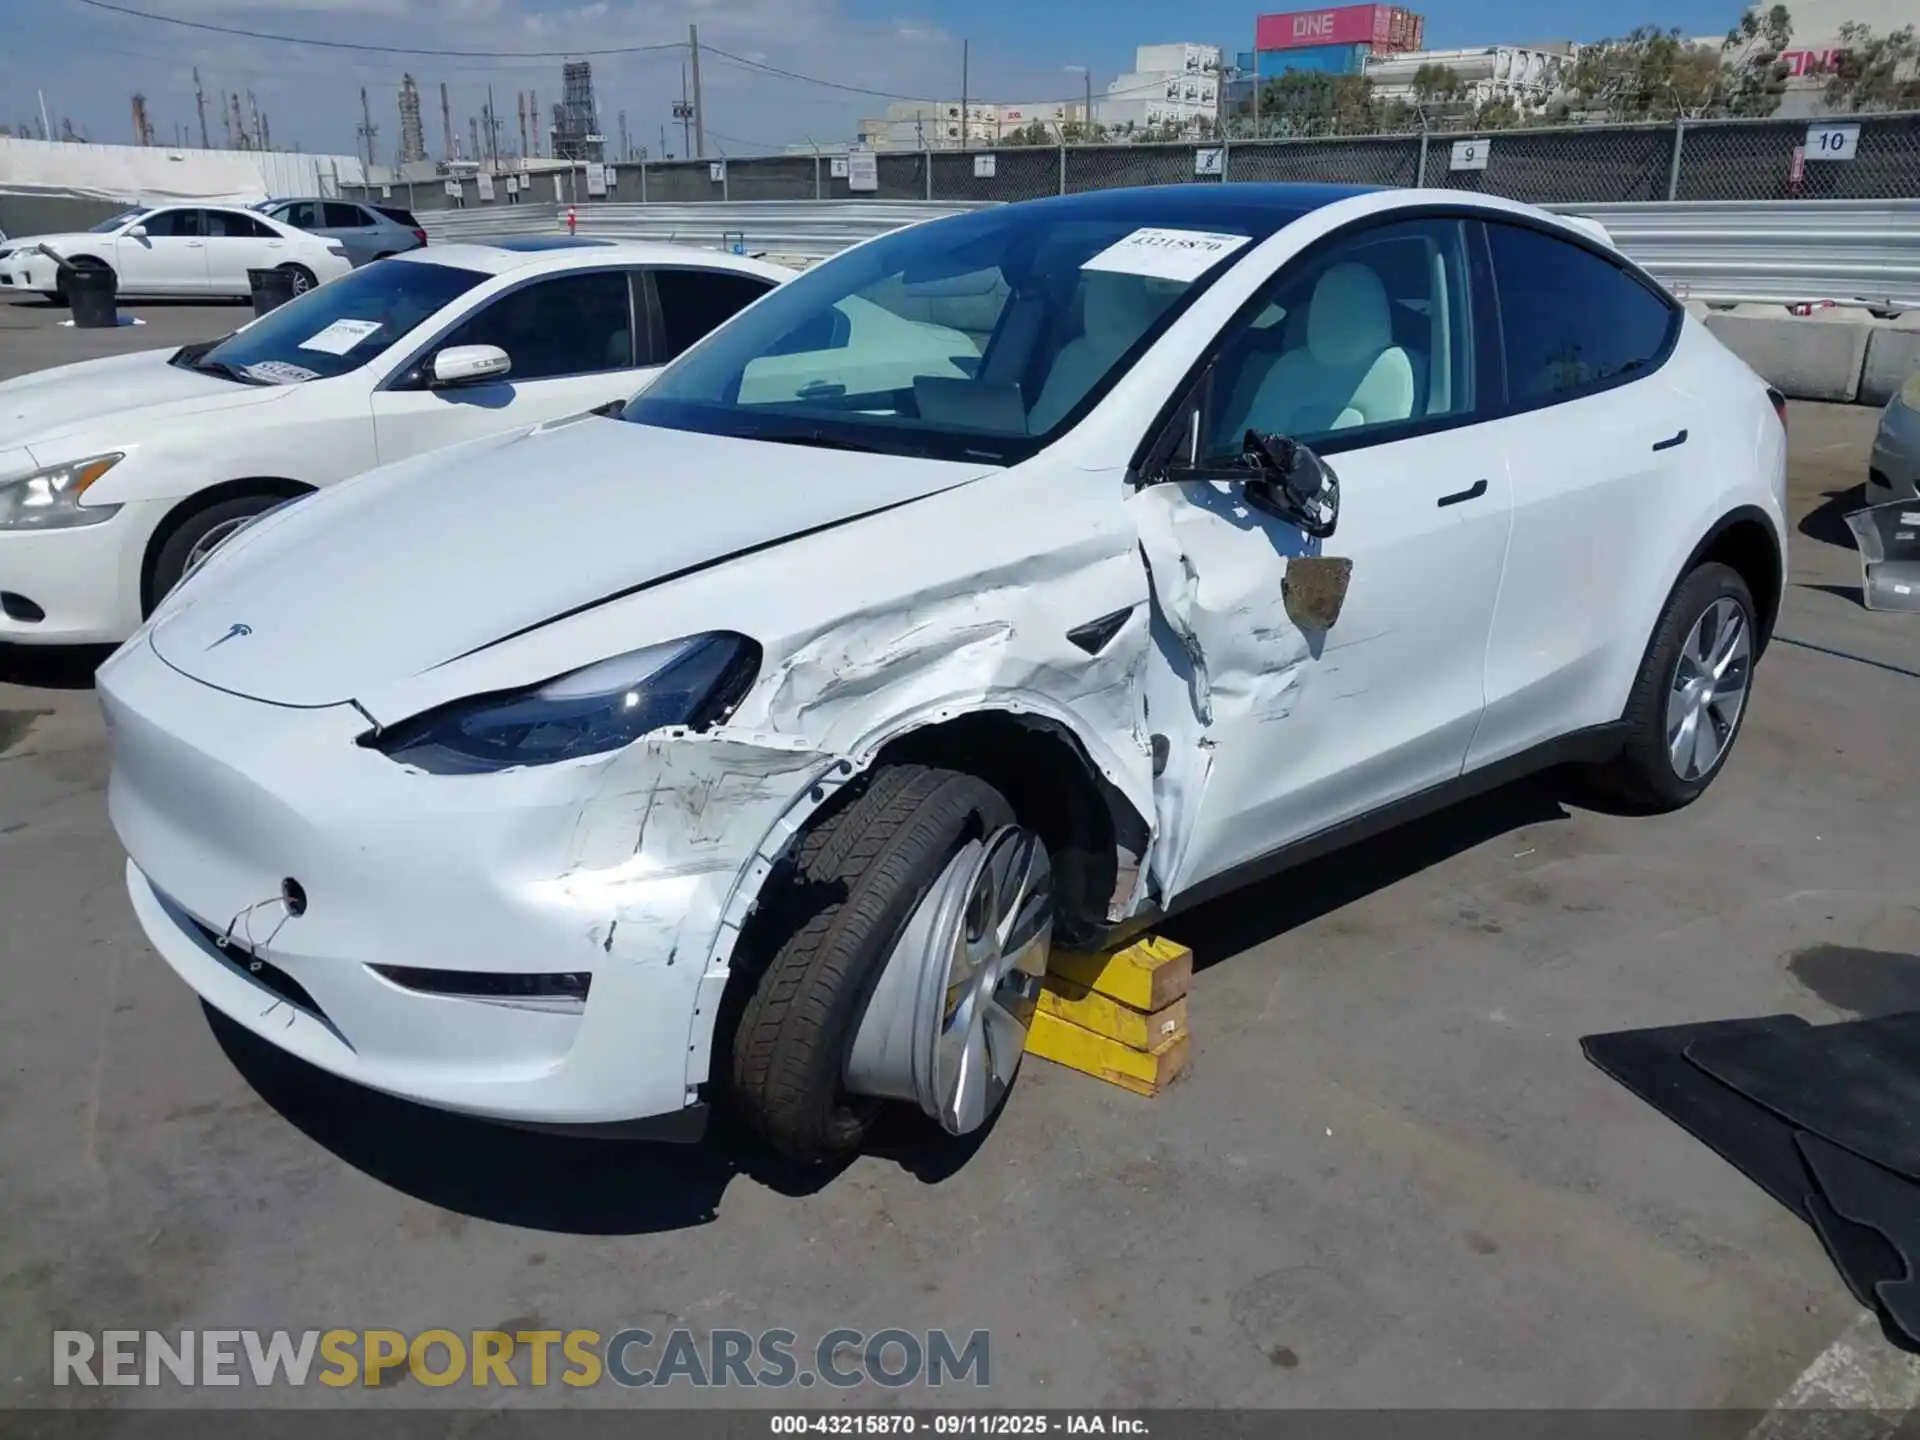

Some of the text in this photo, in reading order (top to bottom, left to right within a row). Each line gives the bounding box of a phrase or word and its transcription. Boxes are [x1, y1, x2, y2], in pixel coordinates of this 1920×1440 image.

[1293, 14, 1334, 36] ONE
[1820, 132, 1844, 151] 10
[1206, 154, 1214, 168] 8
[1465, 146, 1474, 162] 9
